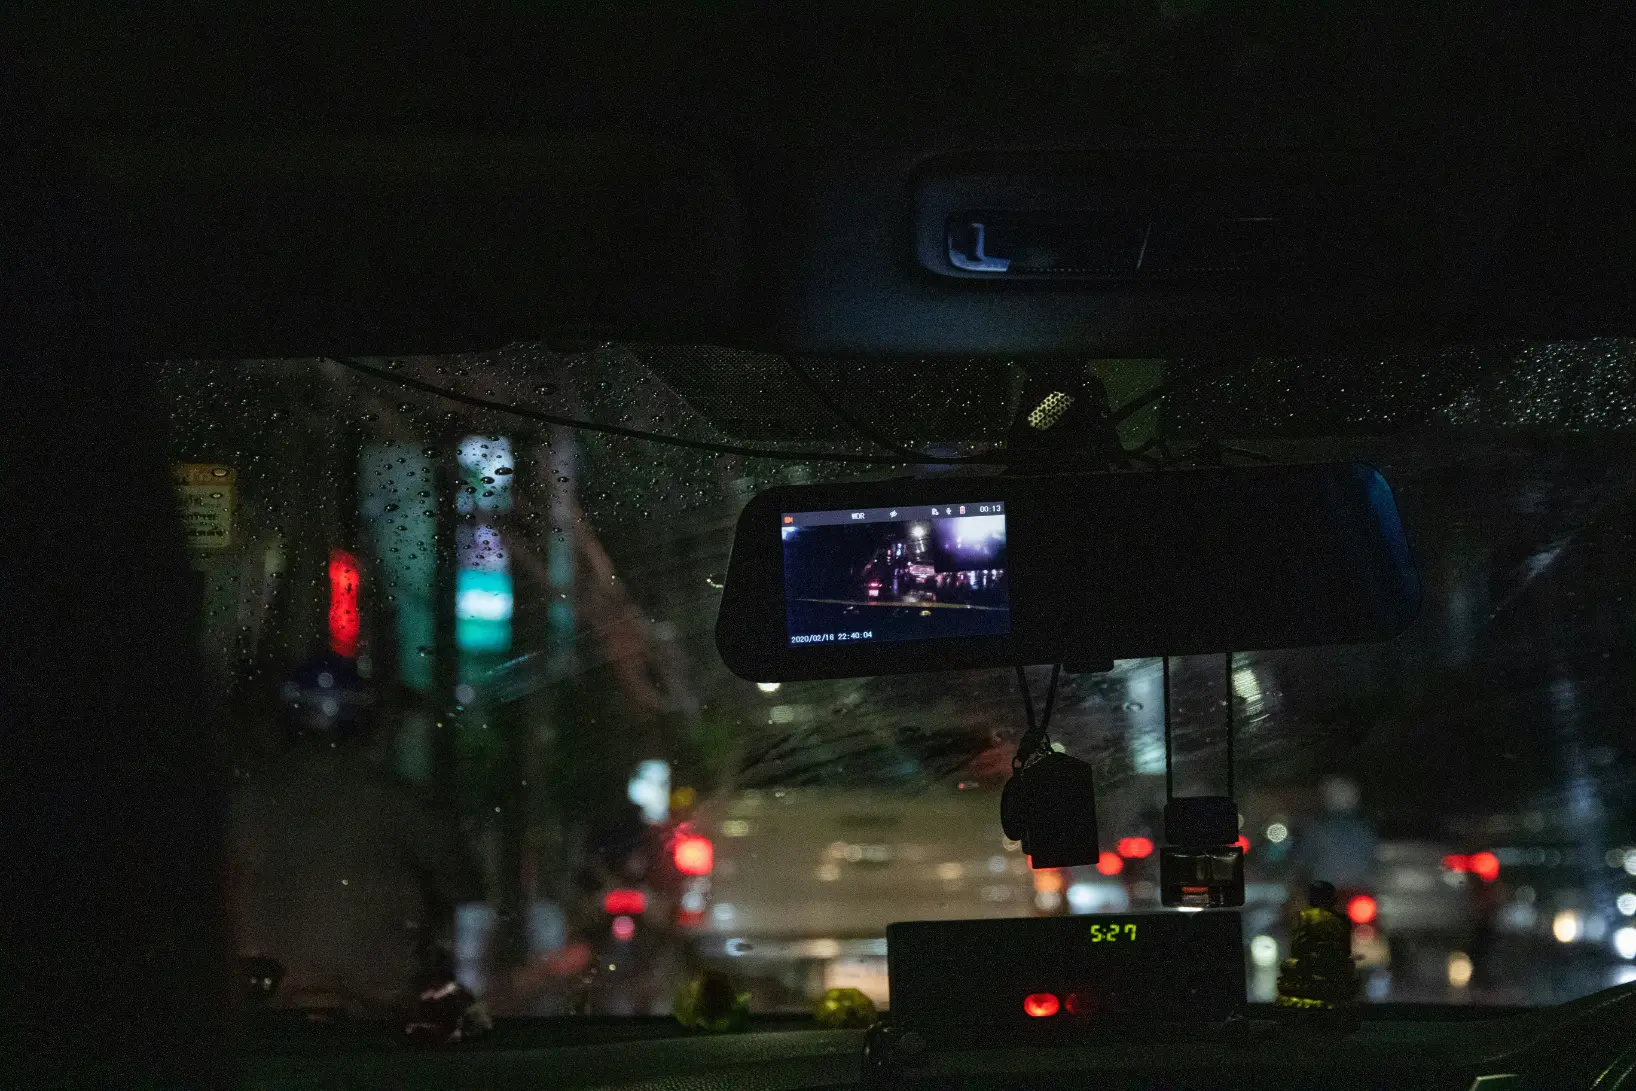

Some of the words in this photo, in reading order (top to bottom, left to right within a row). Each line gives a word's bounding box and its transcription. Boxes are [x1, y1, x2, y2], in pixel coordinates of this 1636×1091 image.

[979, 504, 1001, 513] 00:13
[837, 630, 873, 641] 22:40:04
[1090, 924, 1137, 942] 5:27
